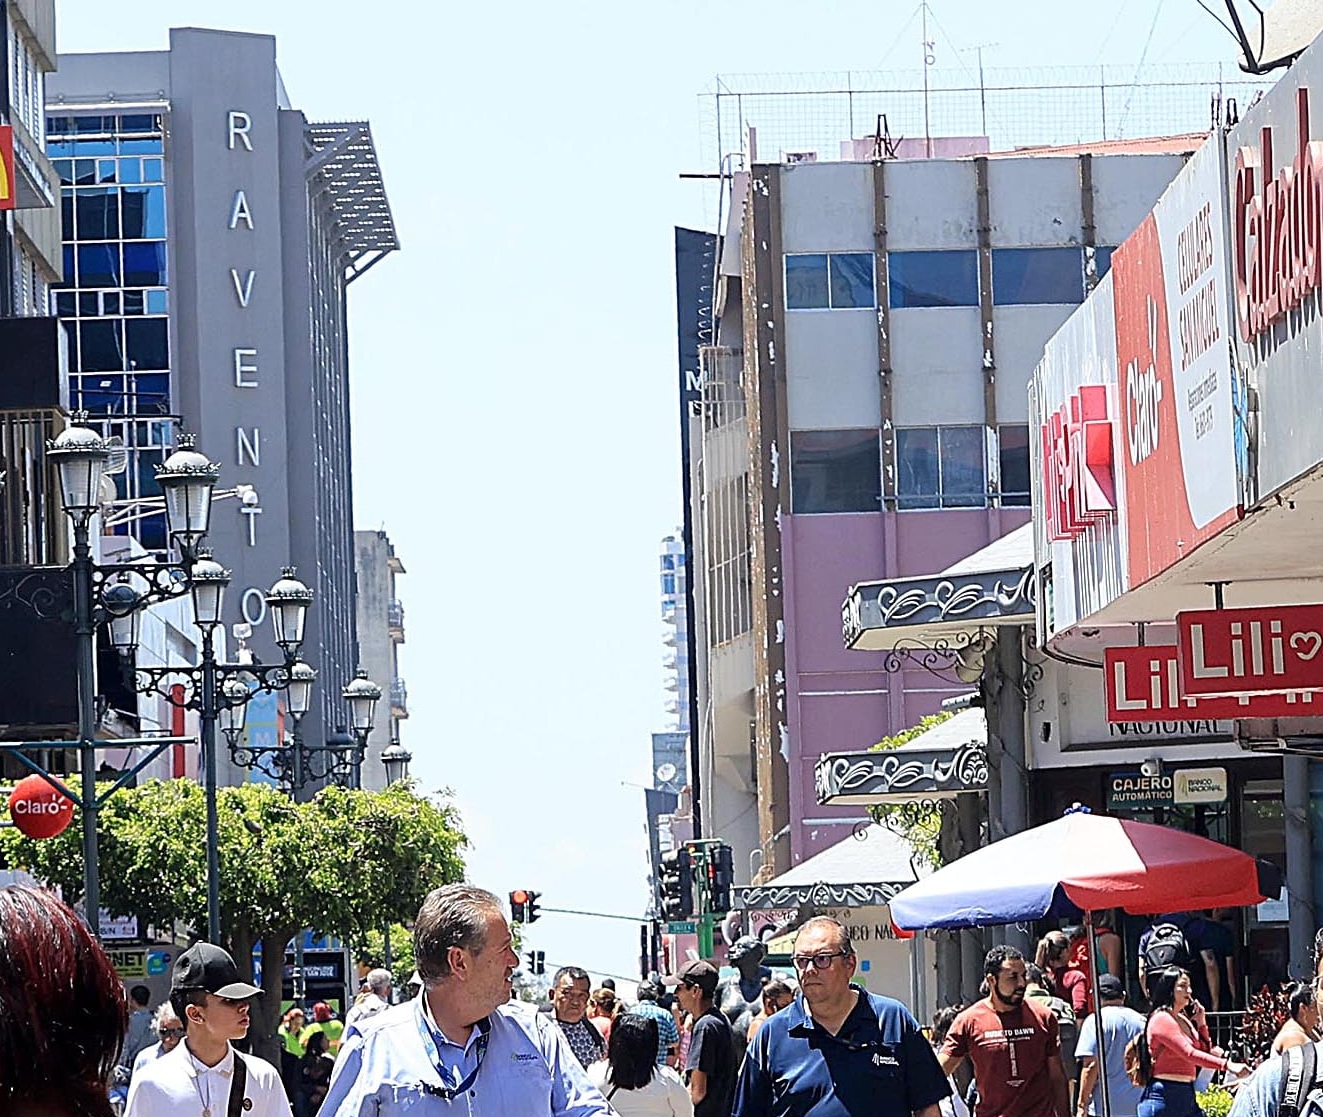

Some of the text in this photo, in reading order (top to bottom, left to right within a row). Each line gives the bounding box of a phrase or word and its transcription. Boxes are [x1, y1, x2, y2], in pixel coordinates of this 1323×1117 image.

[1178, 201, 1213, 295] CELULARES
[227, 111, 267, 627] RAVENTO
[1126, 356, 1162, 467] Claro
[1190, 619, 1285, 679] Lili
[1114, 659, 1197, 710] Lil
[1109, 719, 1229, 736] NACIONAL
[1112, 776, 1172, 792] CAJERO
[1112, 790, 1173, 802] AUTOMÁTICO
[1187, 778, 1214, 786] BANCO
[15, 799, 60, 815] Claro
